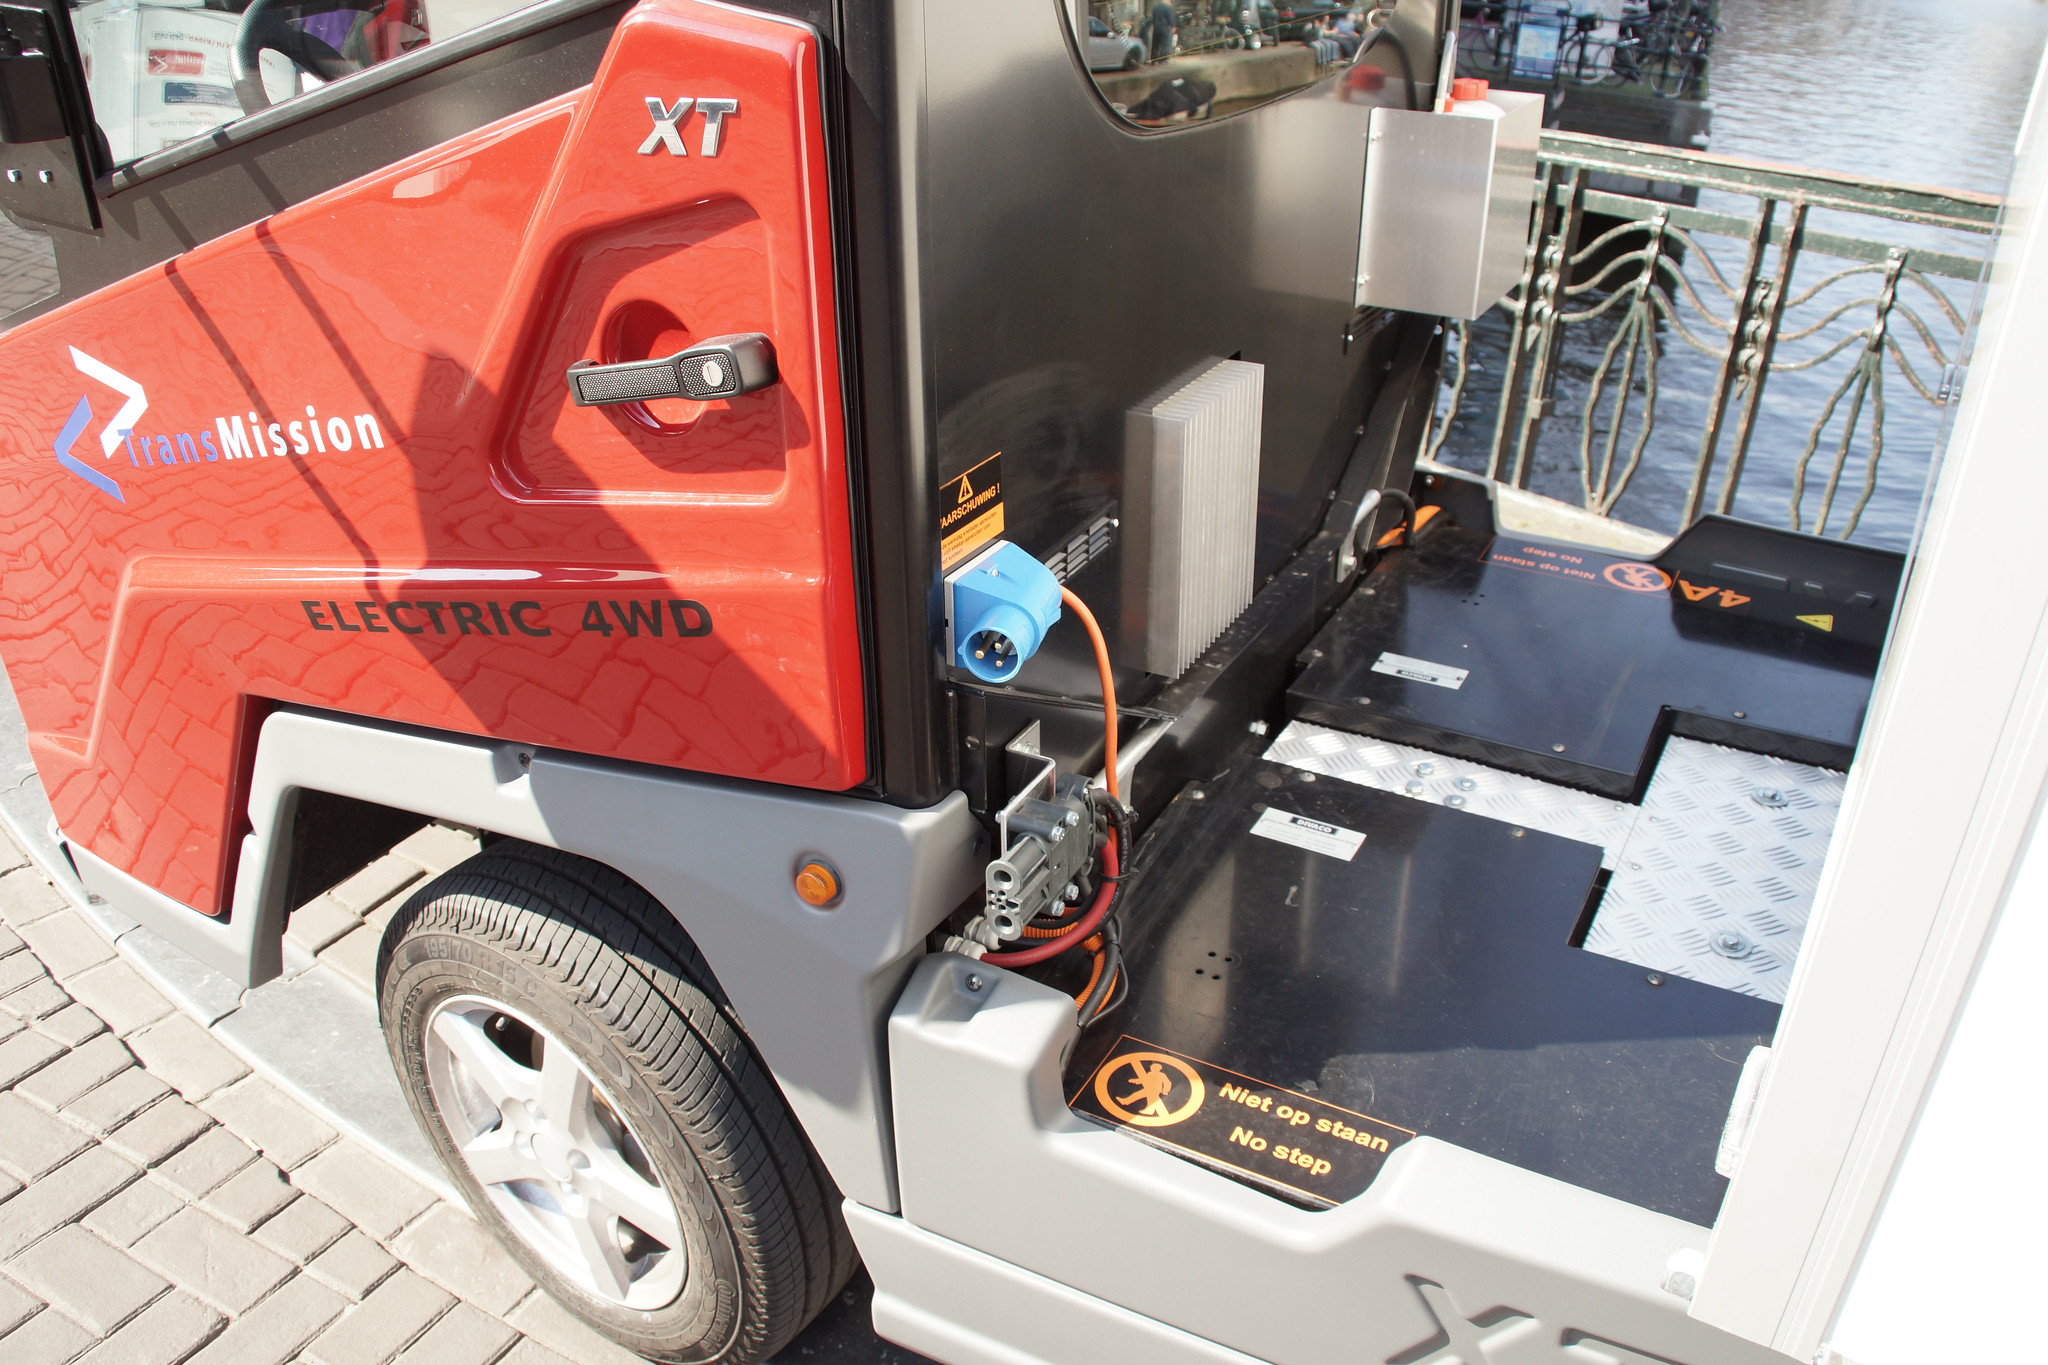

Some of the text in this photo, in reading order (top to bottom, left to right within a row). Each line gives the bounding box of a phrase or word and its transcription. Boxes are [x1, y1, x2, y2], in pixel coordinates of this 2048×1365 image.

[637, 97, 738, 157] XT
[117, 405, 385, 467] TransMission
[940, 485, 996, 529] AARSCHUWING
[1493, 553, 1597, 581] Niet op staan
[1523, 546, 1583, 565] No step
[1678, 579, 1751, 609] 4A
[300, 600, 714, 638] ELECTRIC 4WD
[1297, 819, 1332, 833] DIVACO
[1218, 1082, 1389, 1153] Niet op staan
[1229, 1126, 1332, 1176] No step
